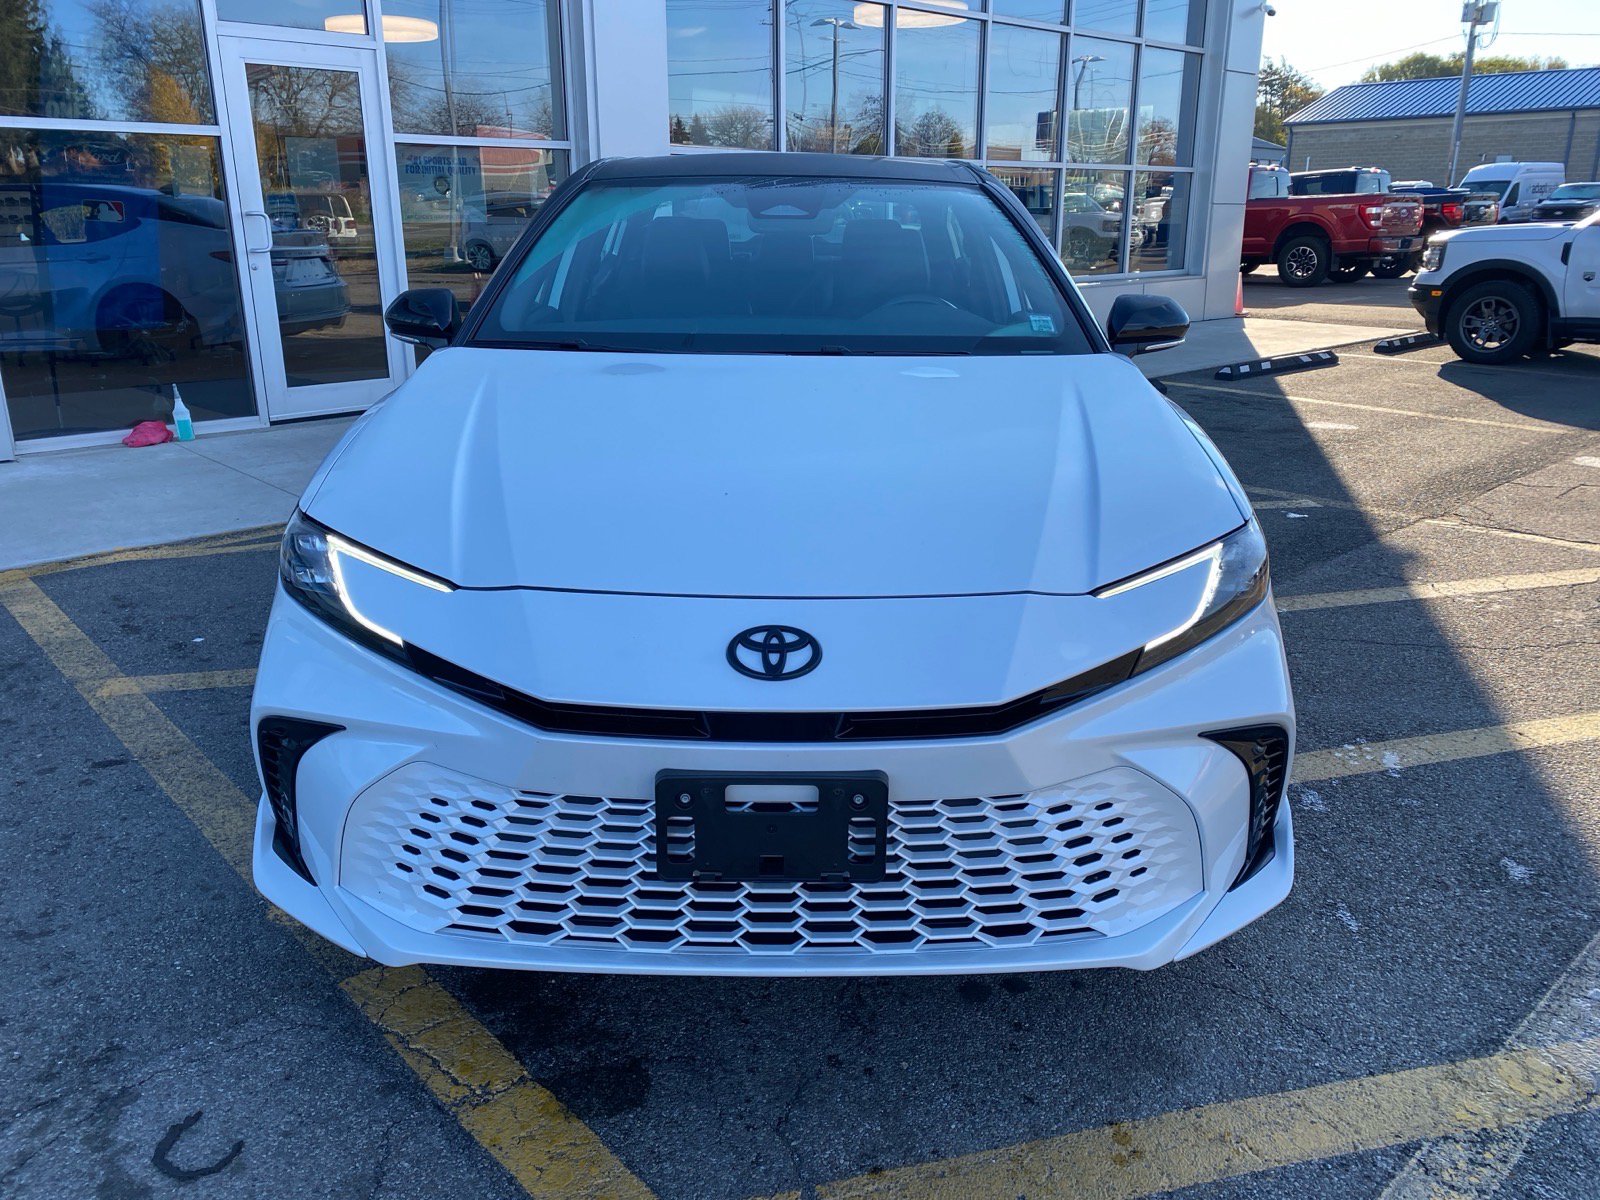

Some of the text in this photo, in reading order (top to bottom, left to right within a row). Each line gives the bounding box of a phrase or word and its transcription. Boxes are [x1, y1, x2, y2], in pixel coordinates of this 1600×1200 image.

[423, 156, 451, 166] SPORTS
[405, 164, 476, 176] FOR INITIAL QALITY
